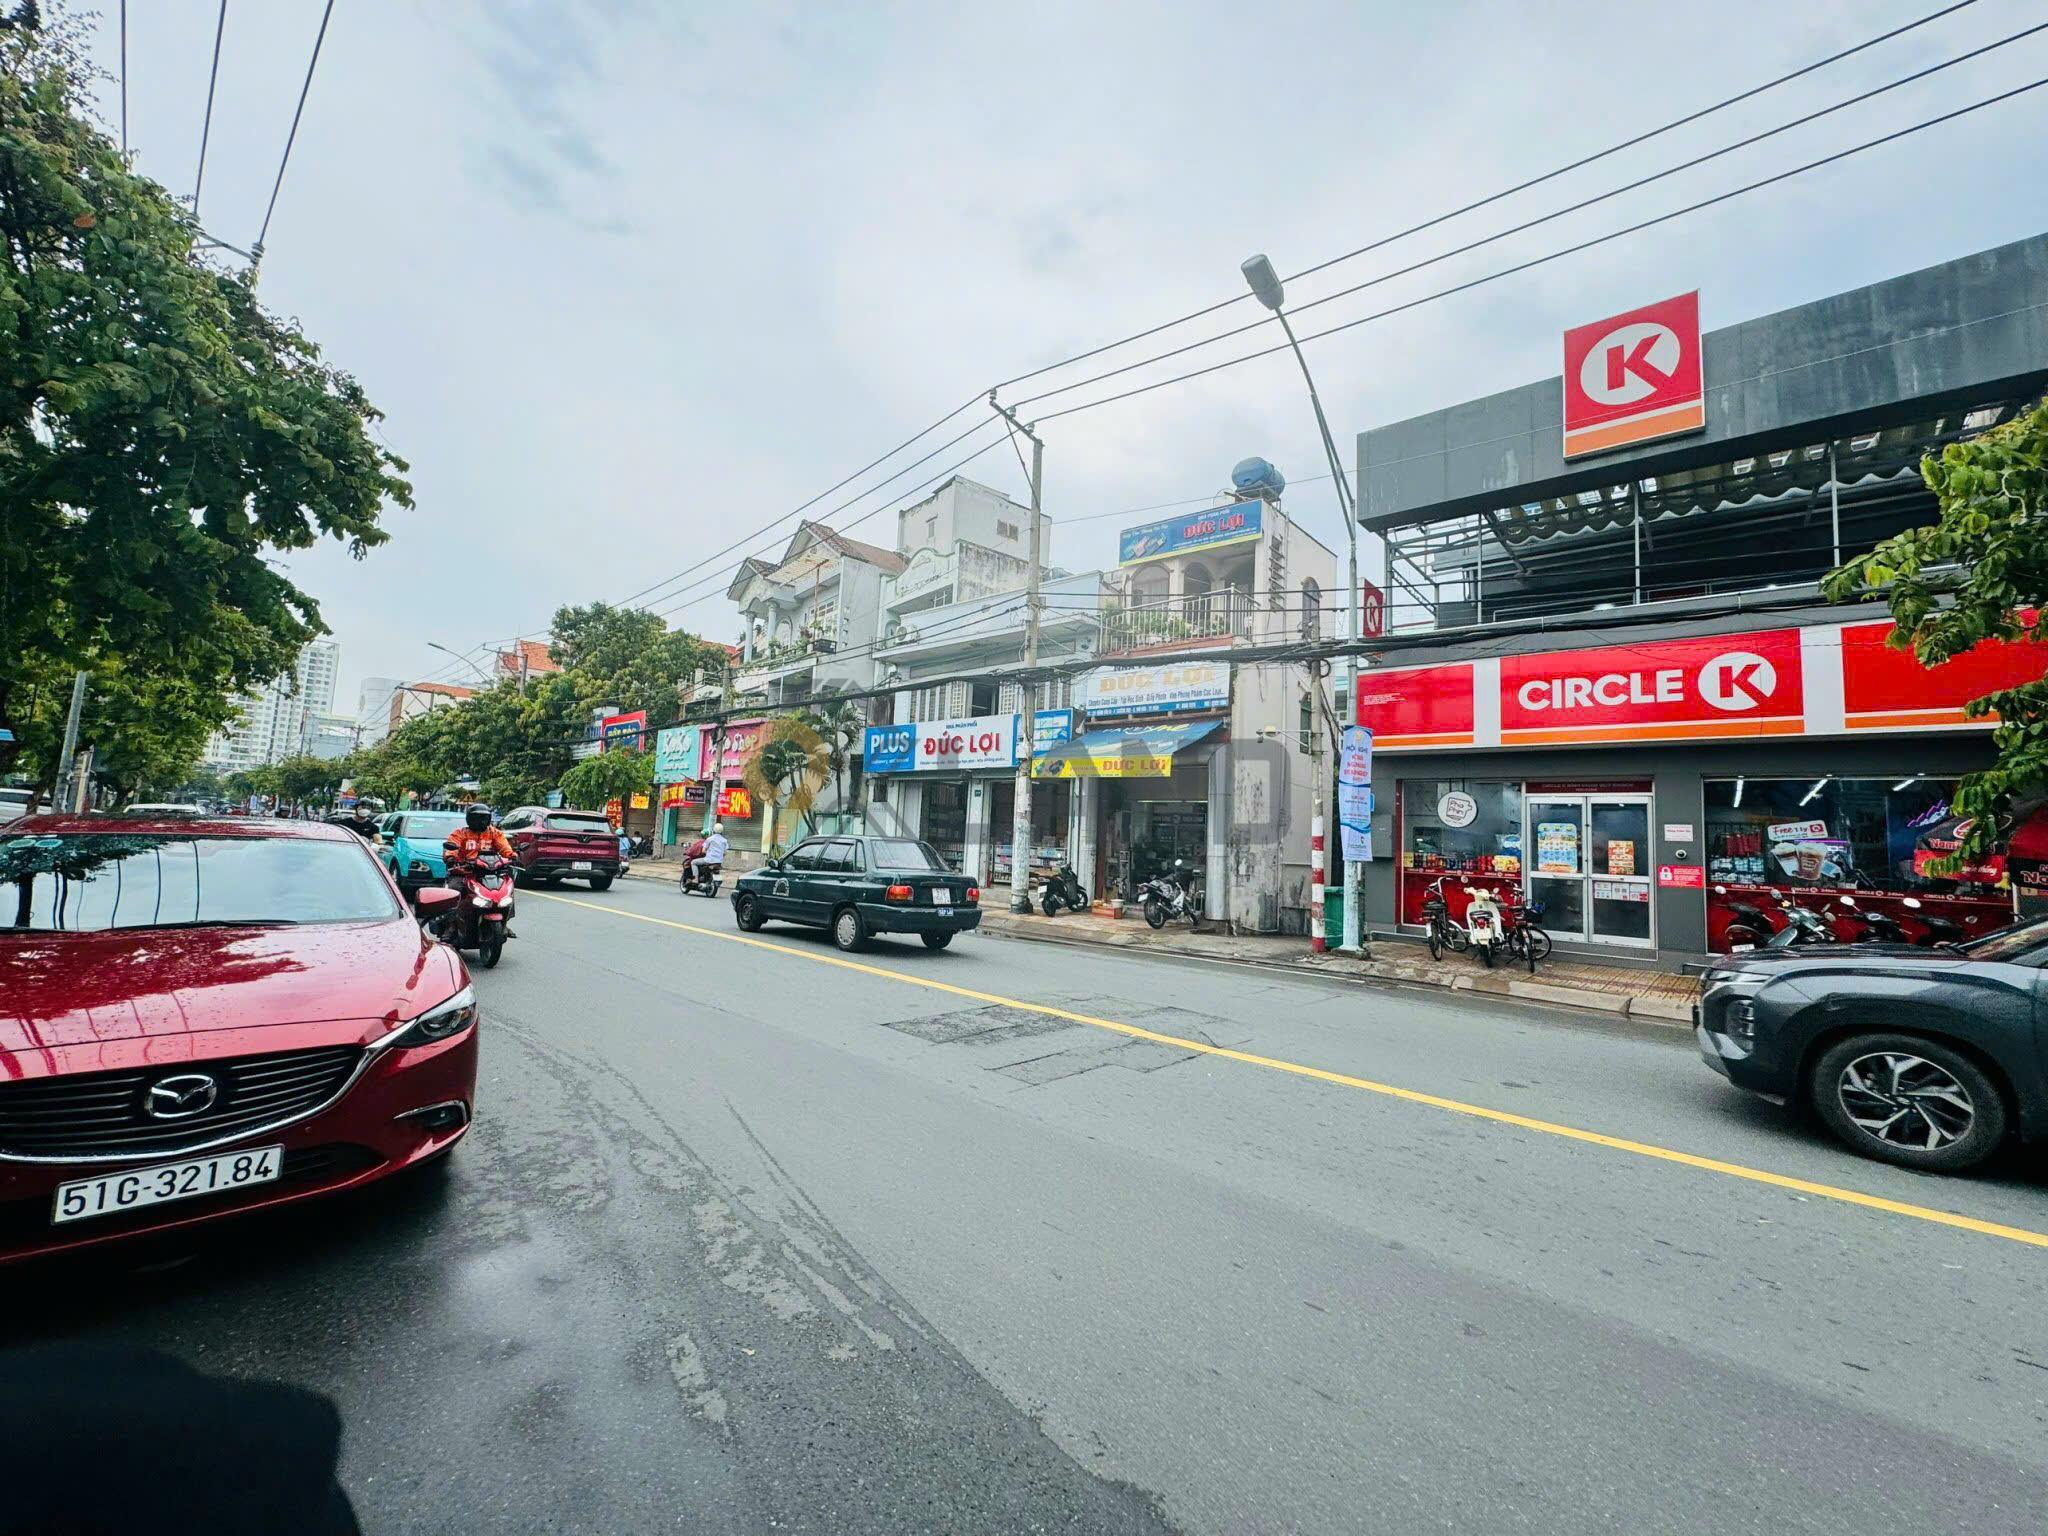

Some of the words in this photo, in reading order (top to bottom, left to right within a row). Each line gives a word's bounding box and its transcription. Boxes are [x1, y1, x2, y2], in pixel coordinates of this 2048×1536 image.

[1607, 333, 1672, 392] K
[1518, 669, 1684, 711] CIRCLE
[870, 731, 909, 754] PLUS
[924, 730, 964, 756] ĐỨC
[970, 732, 1000, 756] LỢI
[730, 791, 751, 814] 50%
[1774, 826, 1793, 836] Free
[63, 1152, 273, 1216] 51G-321.84
